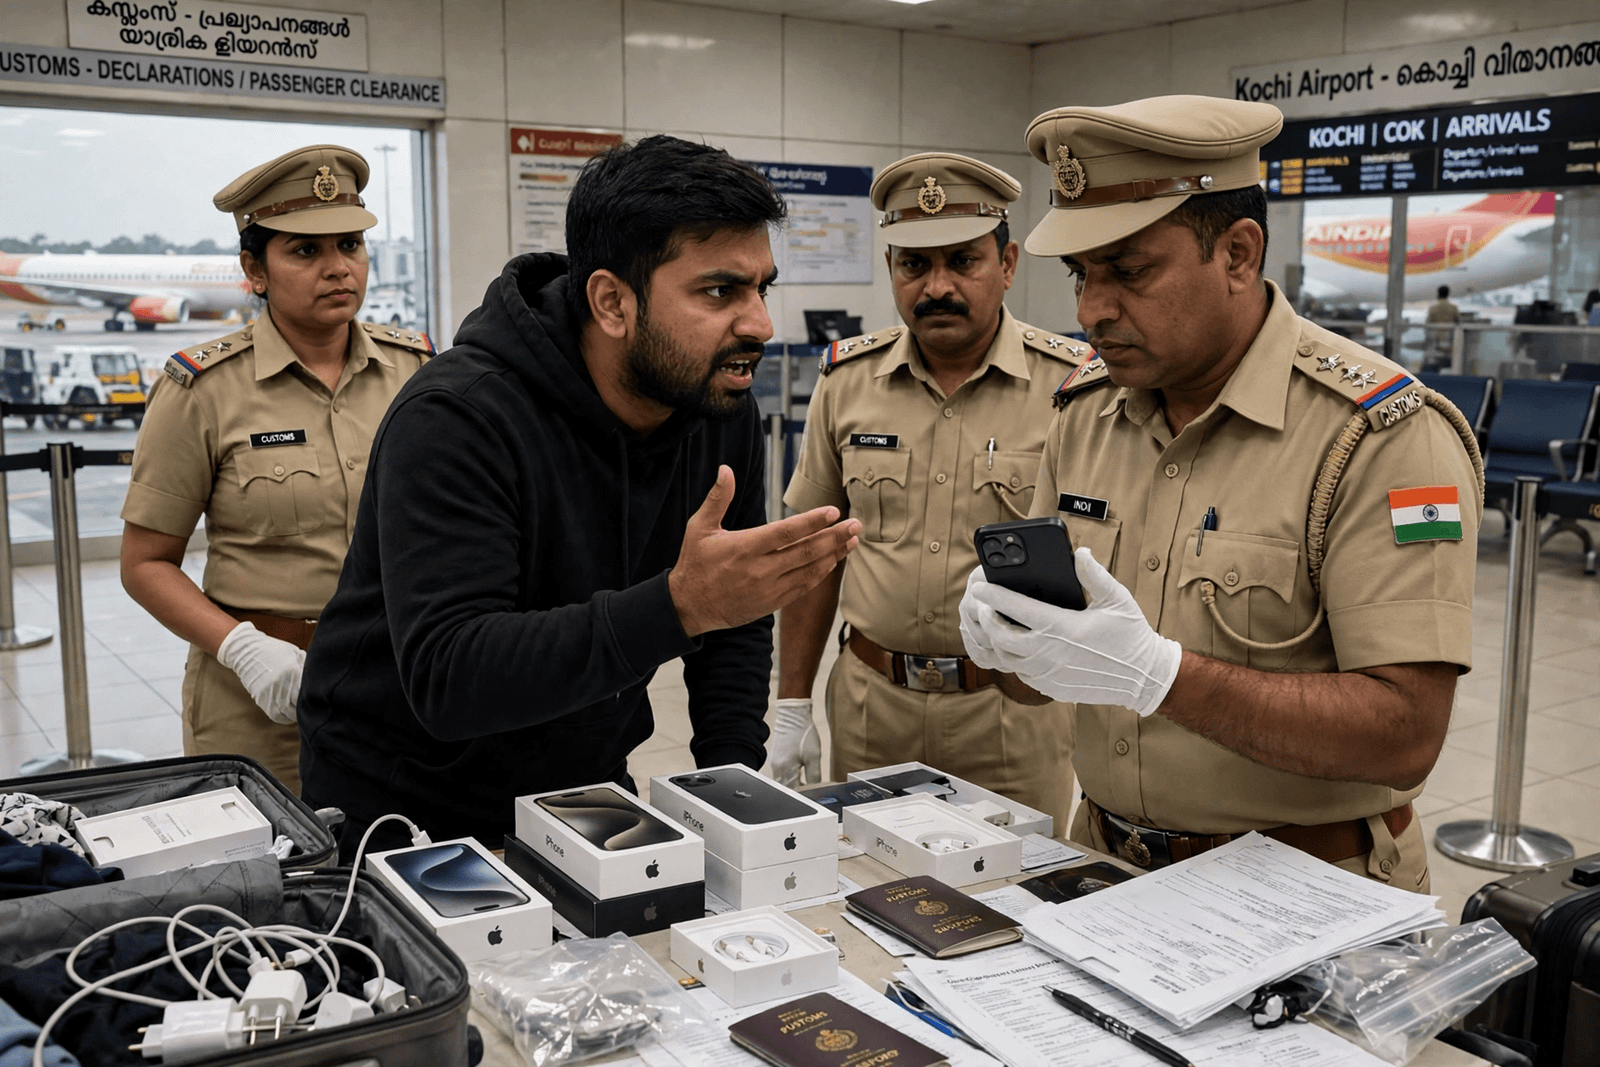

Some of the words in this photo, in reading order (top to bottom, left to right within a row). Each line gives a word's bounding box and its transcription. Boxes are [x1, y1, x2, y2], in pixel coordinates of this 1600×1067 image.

[0, 52, 80, 77] USTOMS
[98, 59, 234, 88] DECLARATIONS
[250, 72, 346, 96] PASSENGER
[350, 79, 440, 102] CLEARANCE
[1235, 72, 1292, 101] Kochi
[1298, 64, 1374, 100] Airport
[1308, 124, 1366, 148] KOCHI
[1383, 119, 1426, 143] COK
[1445, 108, 1552, 139] ARRIVALS
[261, 432, 296, 443] CUSTOMS
